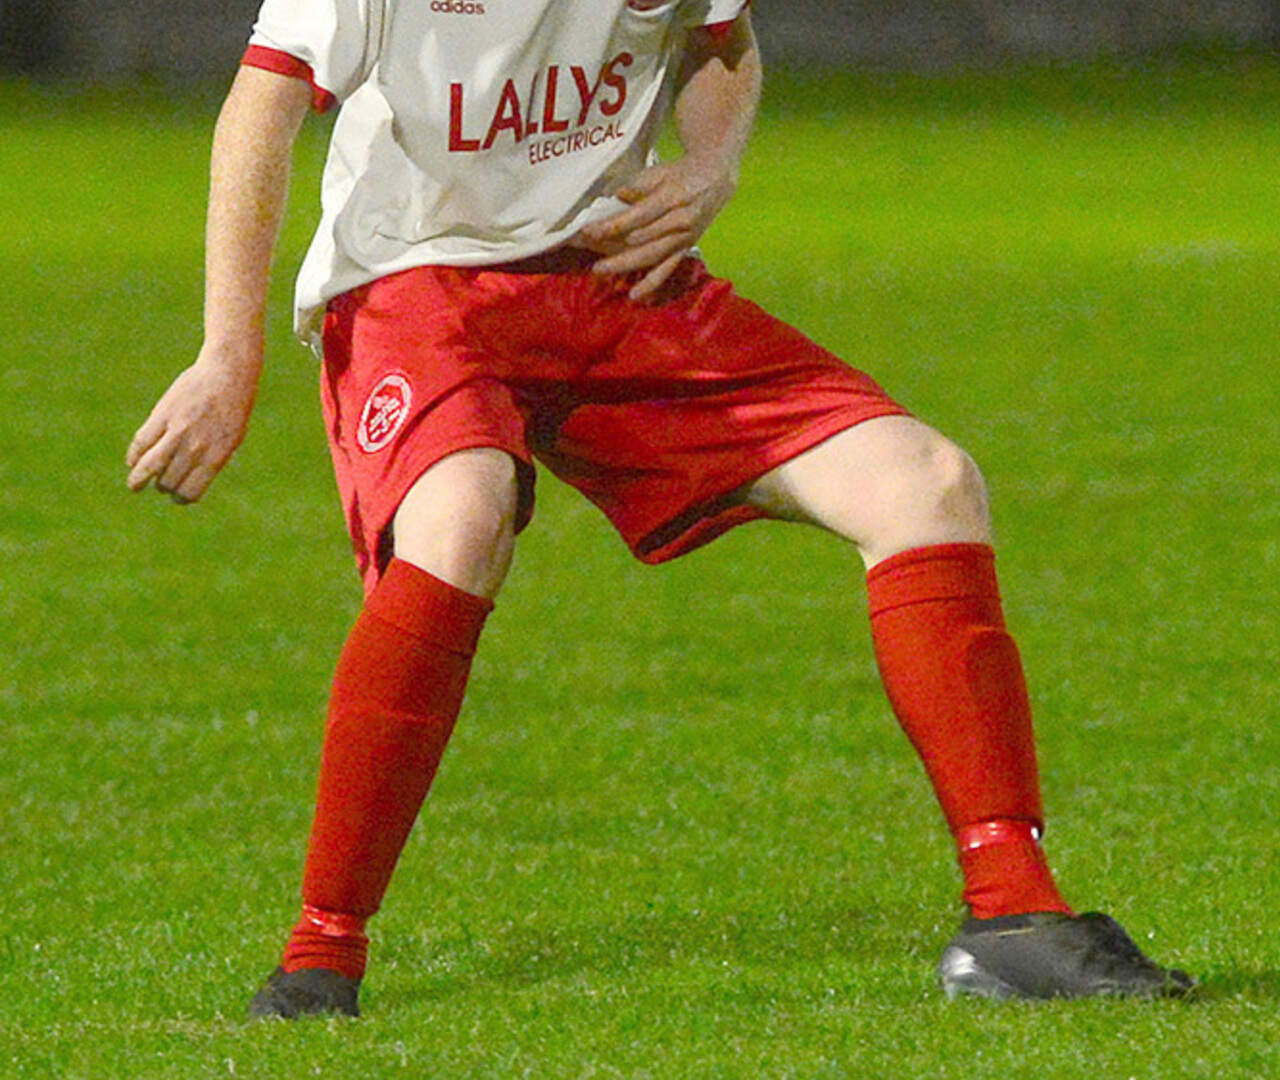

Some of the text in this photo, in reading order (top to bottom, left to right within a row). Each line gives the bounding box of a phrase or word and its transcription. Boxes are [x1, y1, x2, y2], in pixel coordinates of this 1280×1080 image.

[430, 0, 485, 15] adidas
[448, 52, 633, 152] LALLYS
[528, 122, 624, 165] ELECTRICAL
